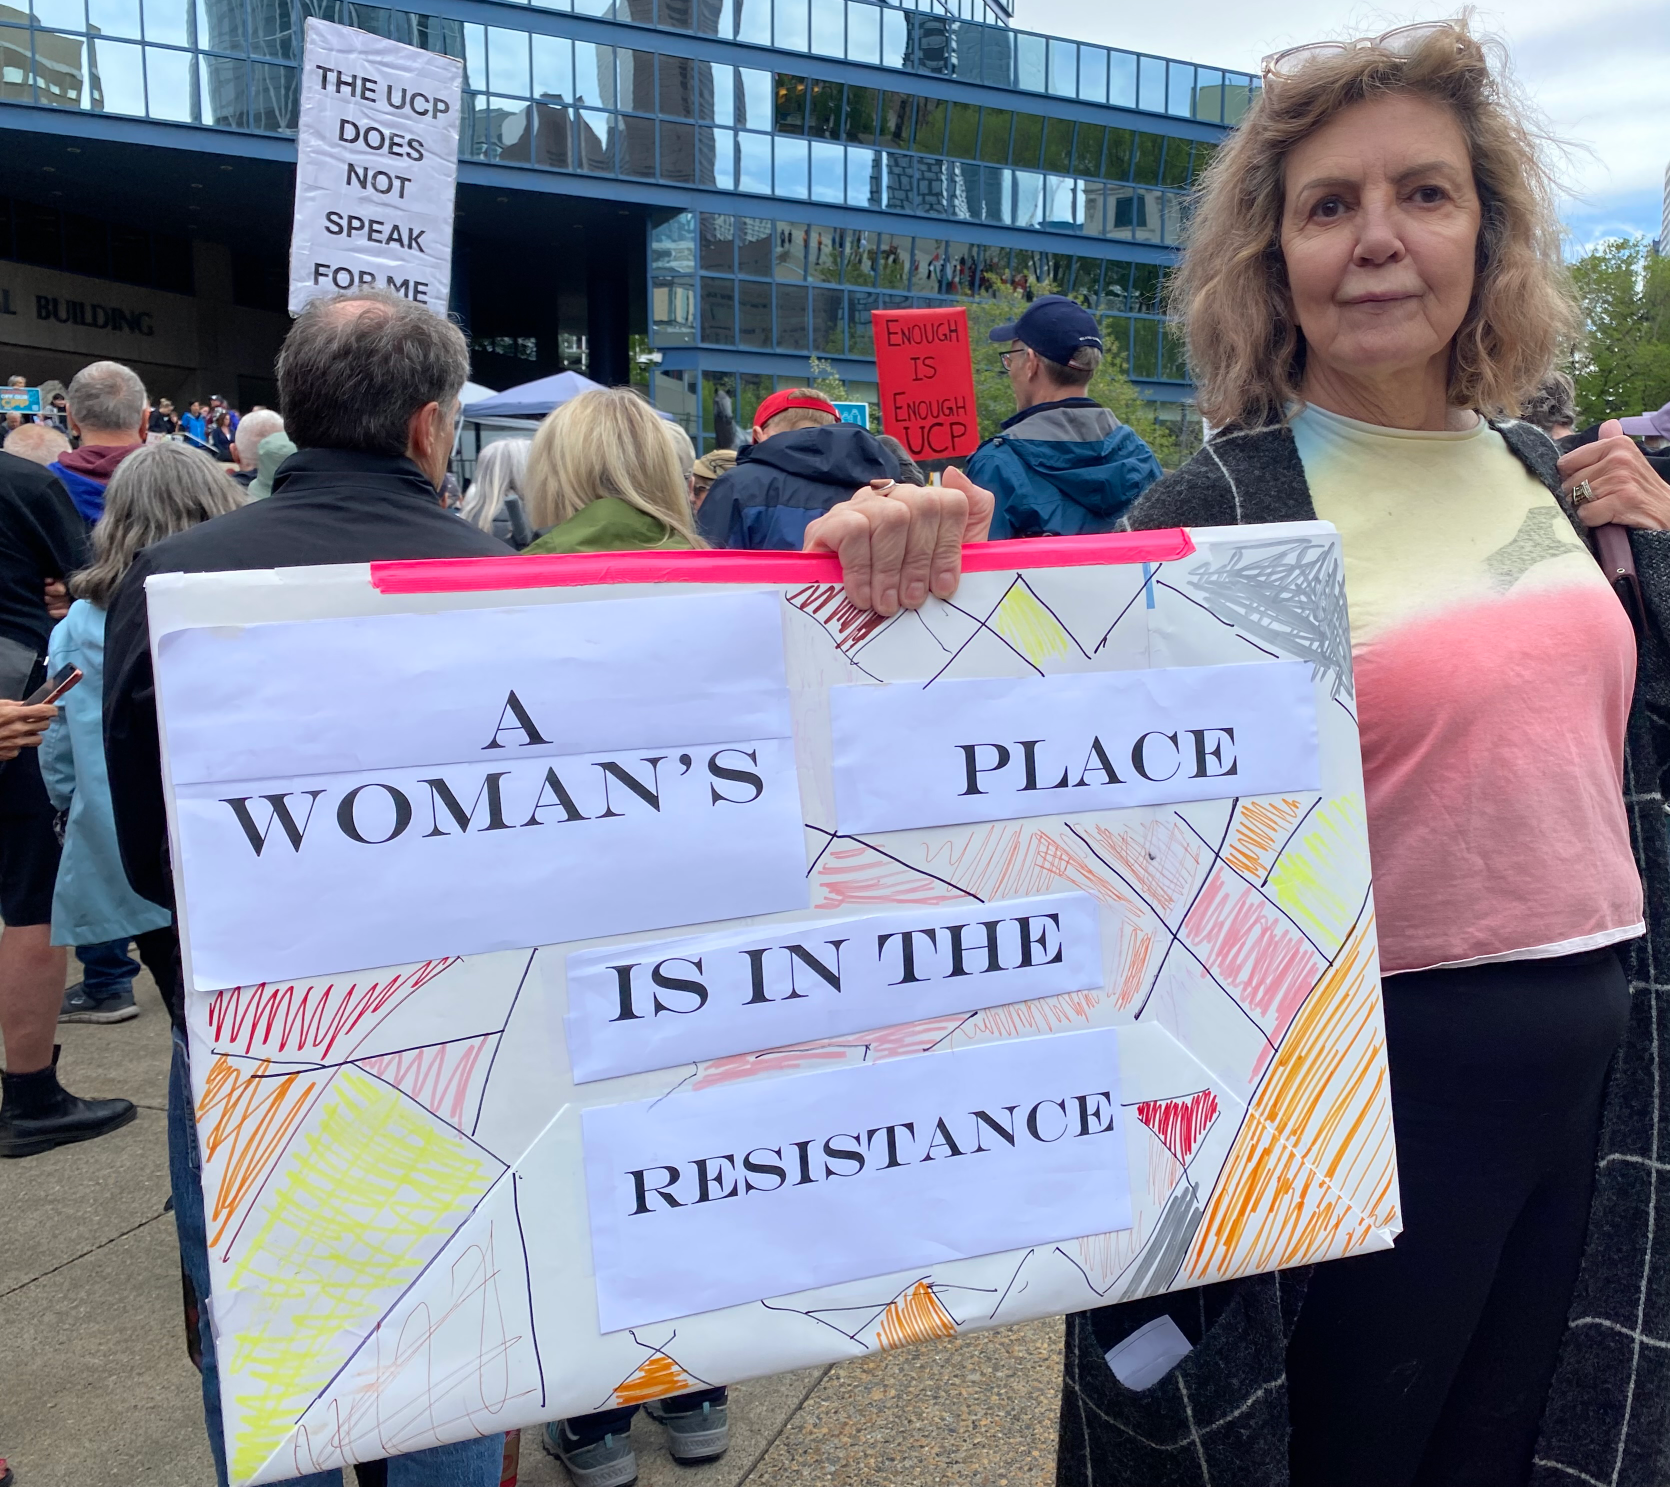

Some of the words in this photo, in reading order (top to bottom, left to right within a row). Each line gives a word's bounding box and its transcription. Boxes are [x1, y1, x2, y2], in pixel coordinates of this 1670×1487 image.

[315, 64, 378, 103] THE
[386, 84, 450, 119] UCP
[338, 118, 424, 162] DOES
[346, 162, 412, 199] NOT
[324, 211, 426, 253] SPEAK
[35, 294, 155, 336] BUILDING
[885, 319, 960, 347] ENOUGH
[910, 356, 937, 381] IS
[893, 391, 968, 422] ENOUGH
[903, 421, 967, 455] UCP
[481, 689, 554, 750] A
[218, 748, 764, 857] WOMAN'S
[955, 727, 1239, 796] PLACE
[606, 956, 709, 1022] IS
[741, 939, 850, 1006] IN
[877, 912, 1064, 985] THE
[625, 1090, 1115, 1217] RESISTANCE
